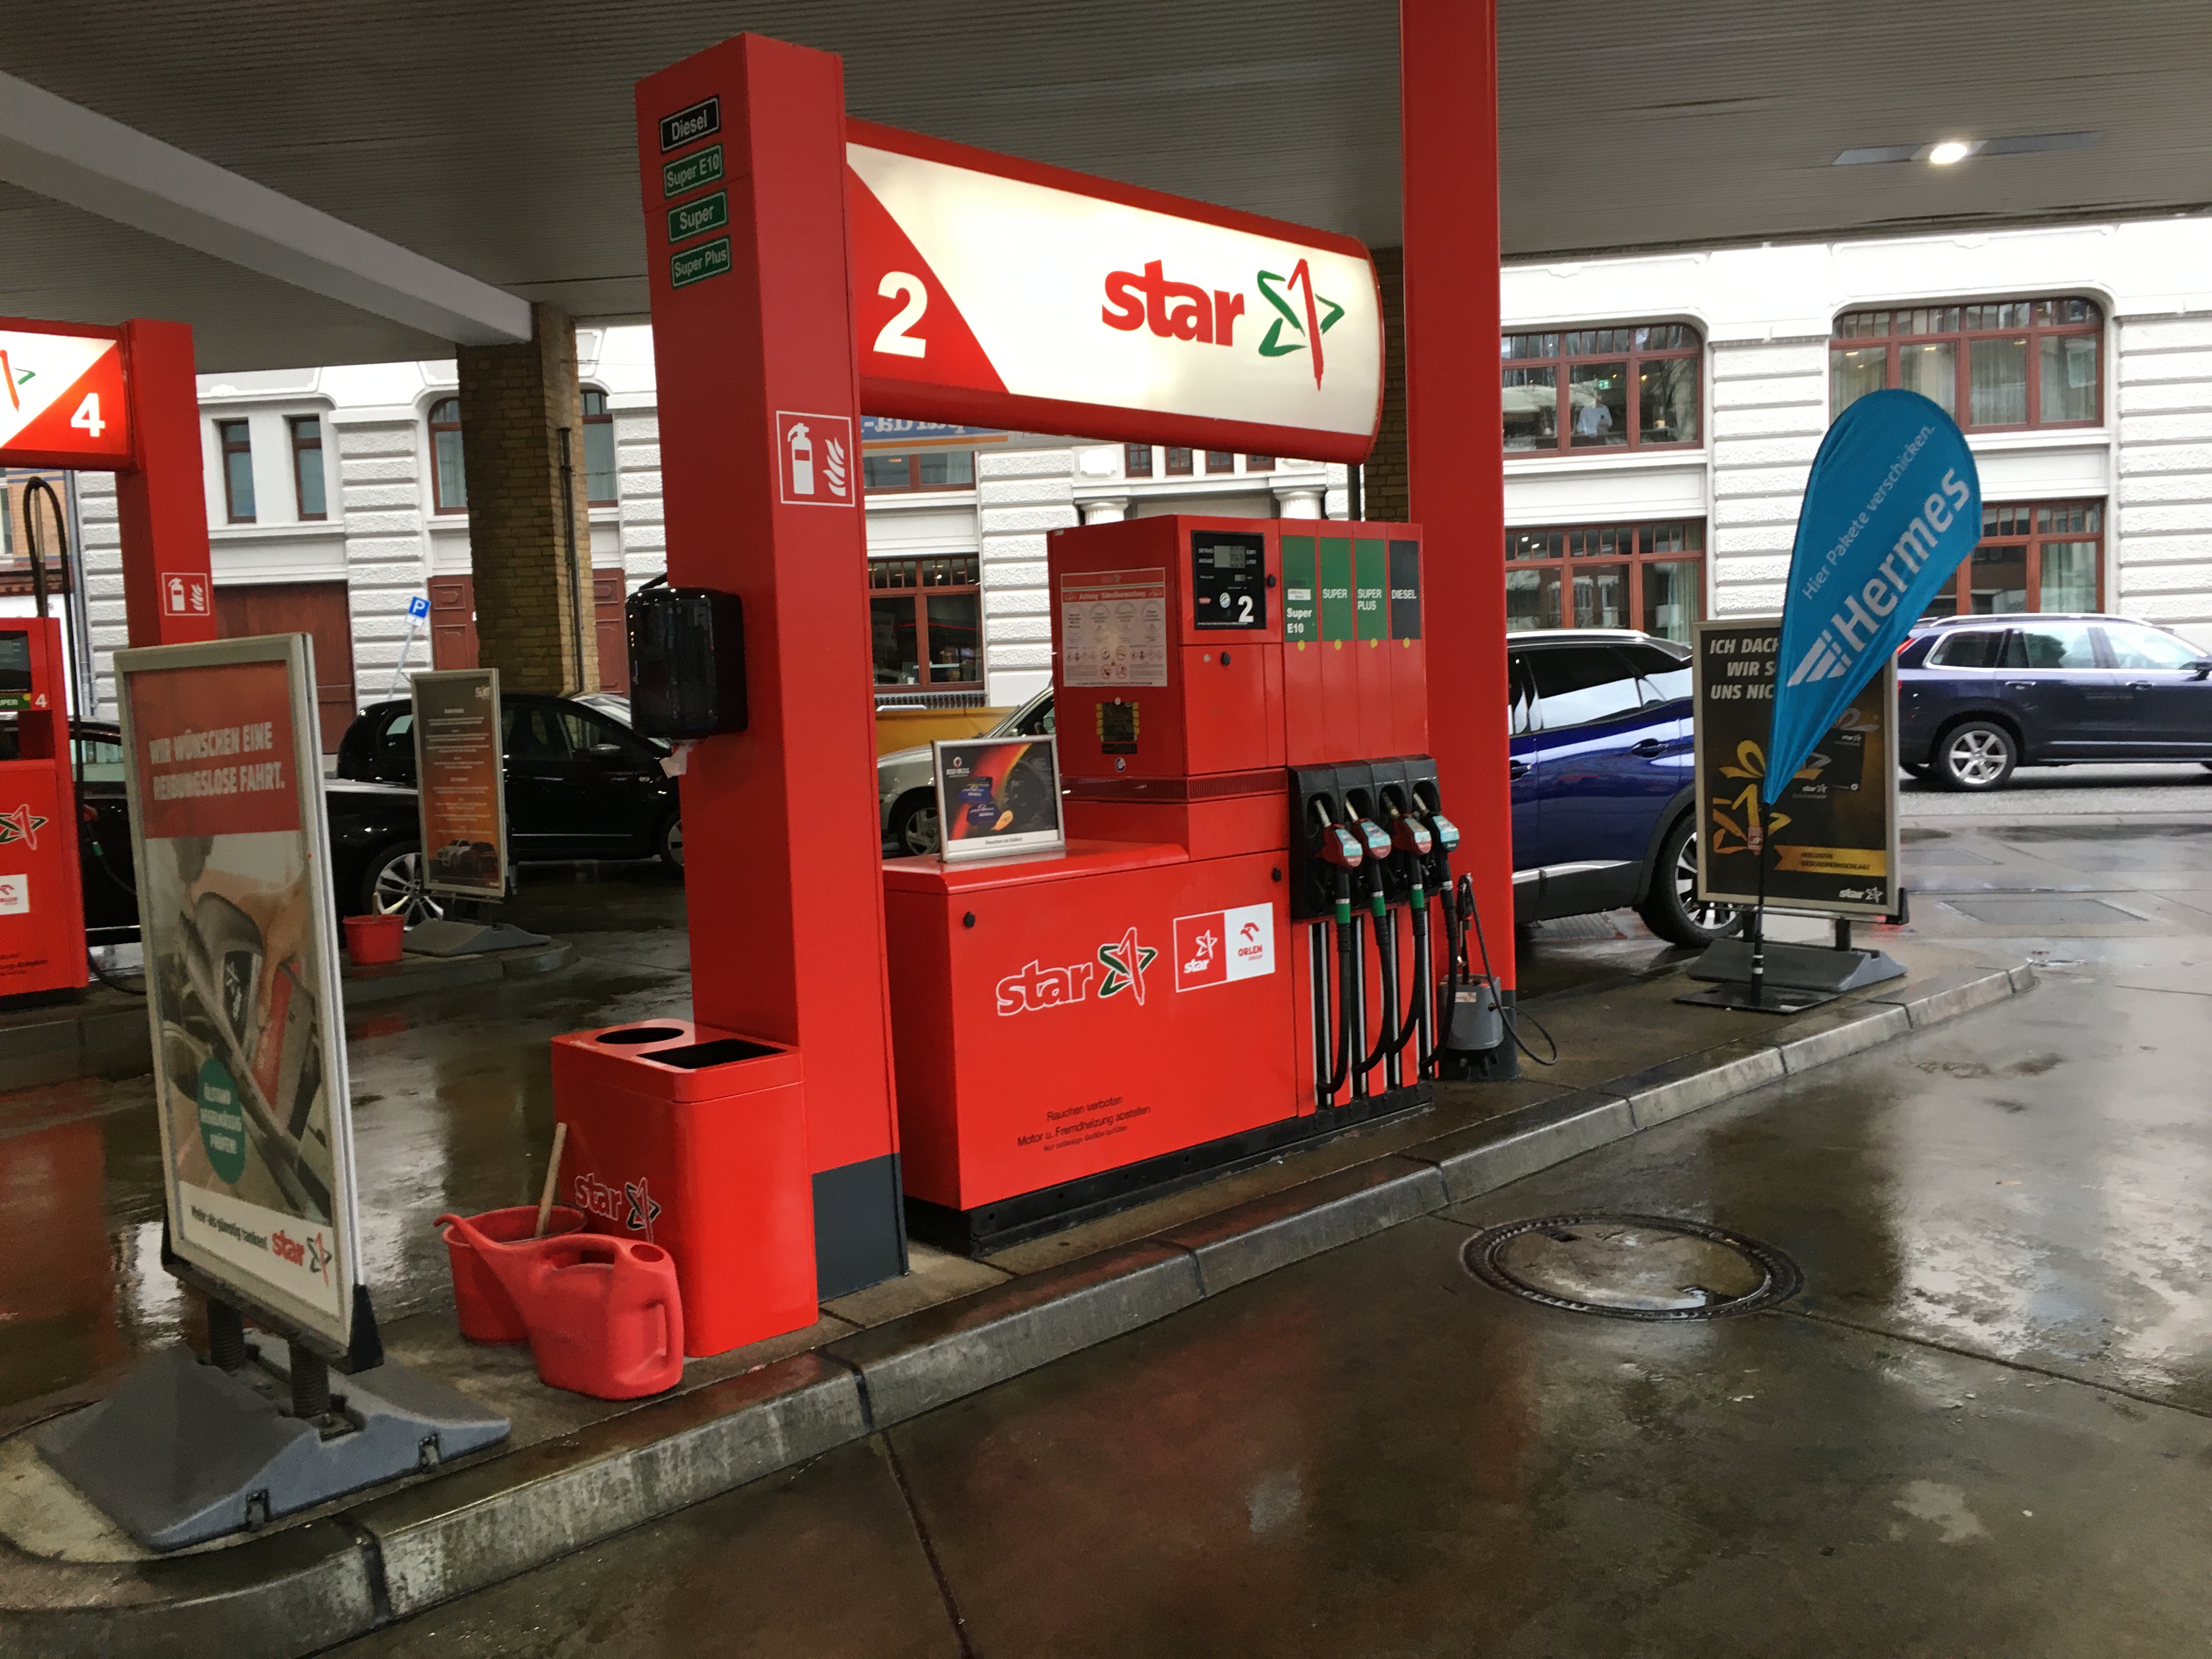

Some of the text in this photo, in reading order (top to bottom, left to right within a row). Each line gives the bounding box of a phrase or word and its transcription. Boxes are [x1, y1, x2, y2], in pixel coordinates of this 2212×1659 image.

[671, 109, 707, 140] Diesel
[667, 153, 720, 188] Super E10
[679, 205, 714, 230] Super
[674, 247, 727, 277] Super Plus
[872, 270, 928, 359] 2
[1102, 259, 1245, 347] star
[70, 392, 105, 437] 4
[1802, 425, 1936, 600] Hier Pakete verschicken.
[1830, 467, 1971, 648] Hermes
[1322, 588, 1348, 599] SUPER
[1357, 588, 1382, 599] SUPER
[1357, 601, 1377, 611] PLUS
[1391, 589, 1417, 600] DIESEL
[412, 600, 426, 613] P
[1238, 595, 1254, 622] 2
[1286, 607, 1312, 620] Super
[1287, 623, 1304, 634] E10
[1709, 639, 1736, 654] ICH
[1727, 661, 1760, 676] WIR
[35, 693, 48, 708] 4
[1711, 685, 1742, 699] UNS
[242, 721, 273, 752] EINE
[1238, 944, 1263, 957] ORLEN
[1183, 958, 1210, 974] star
[995, 958, 1094, 1017] star
[1046, 1096, 1123, 1121] Rauchen verboten
[1017, 1132, 1044, 1147] Motor
[1055, 1115, 1114, 1136] Fremdheizung
[1115, 1105, 1151, 1121] abstellen
[574, 1172, 622, 1221] star
[272, 1229, 304, 1266] star
